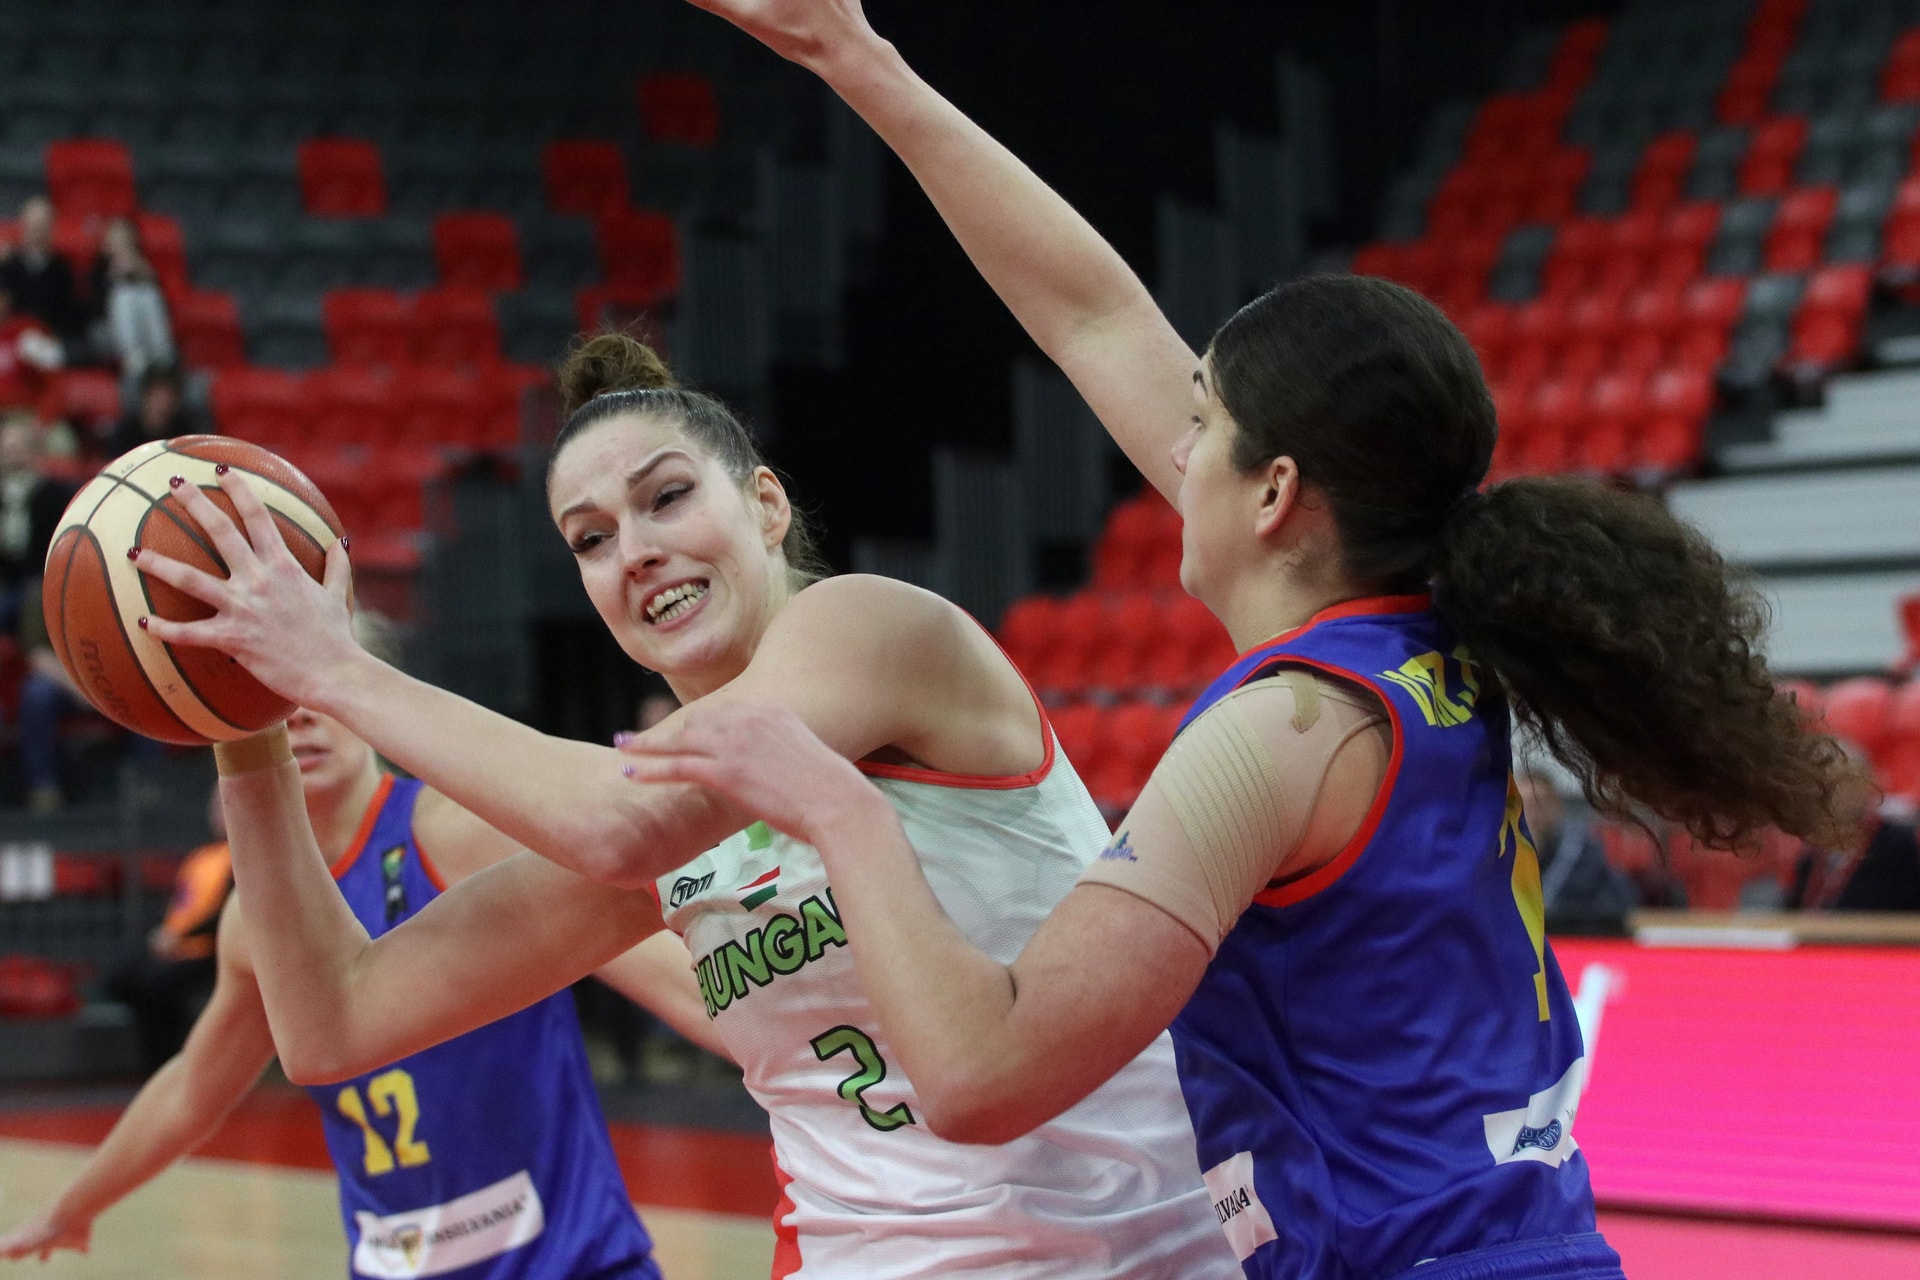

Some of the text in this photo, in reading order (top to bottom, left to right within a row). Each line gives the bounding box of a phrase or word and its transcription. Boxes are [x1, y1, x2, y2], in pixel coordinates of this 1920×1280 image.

[694, 886, 848, 1020] HUNGA
[337, 1068, 431, 1177] 12
[808, 1025, 916, 1131] 2
